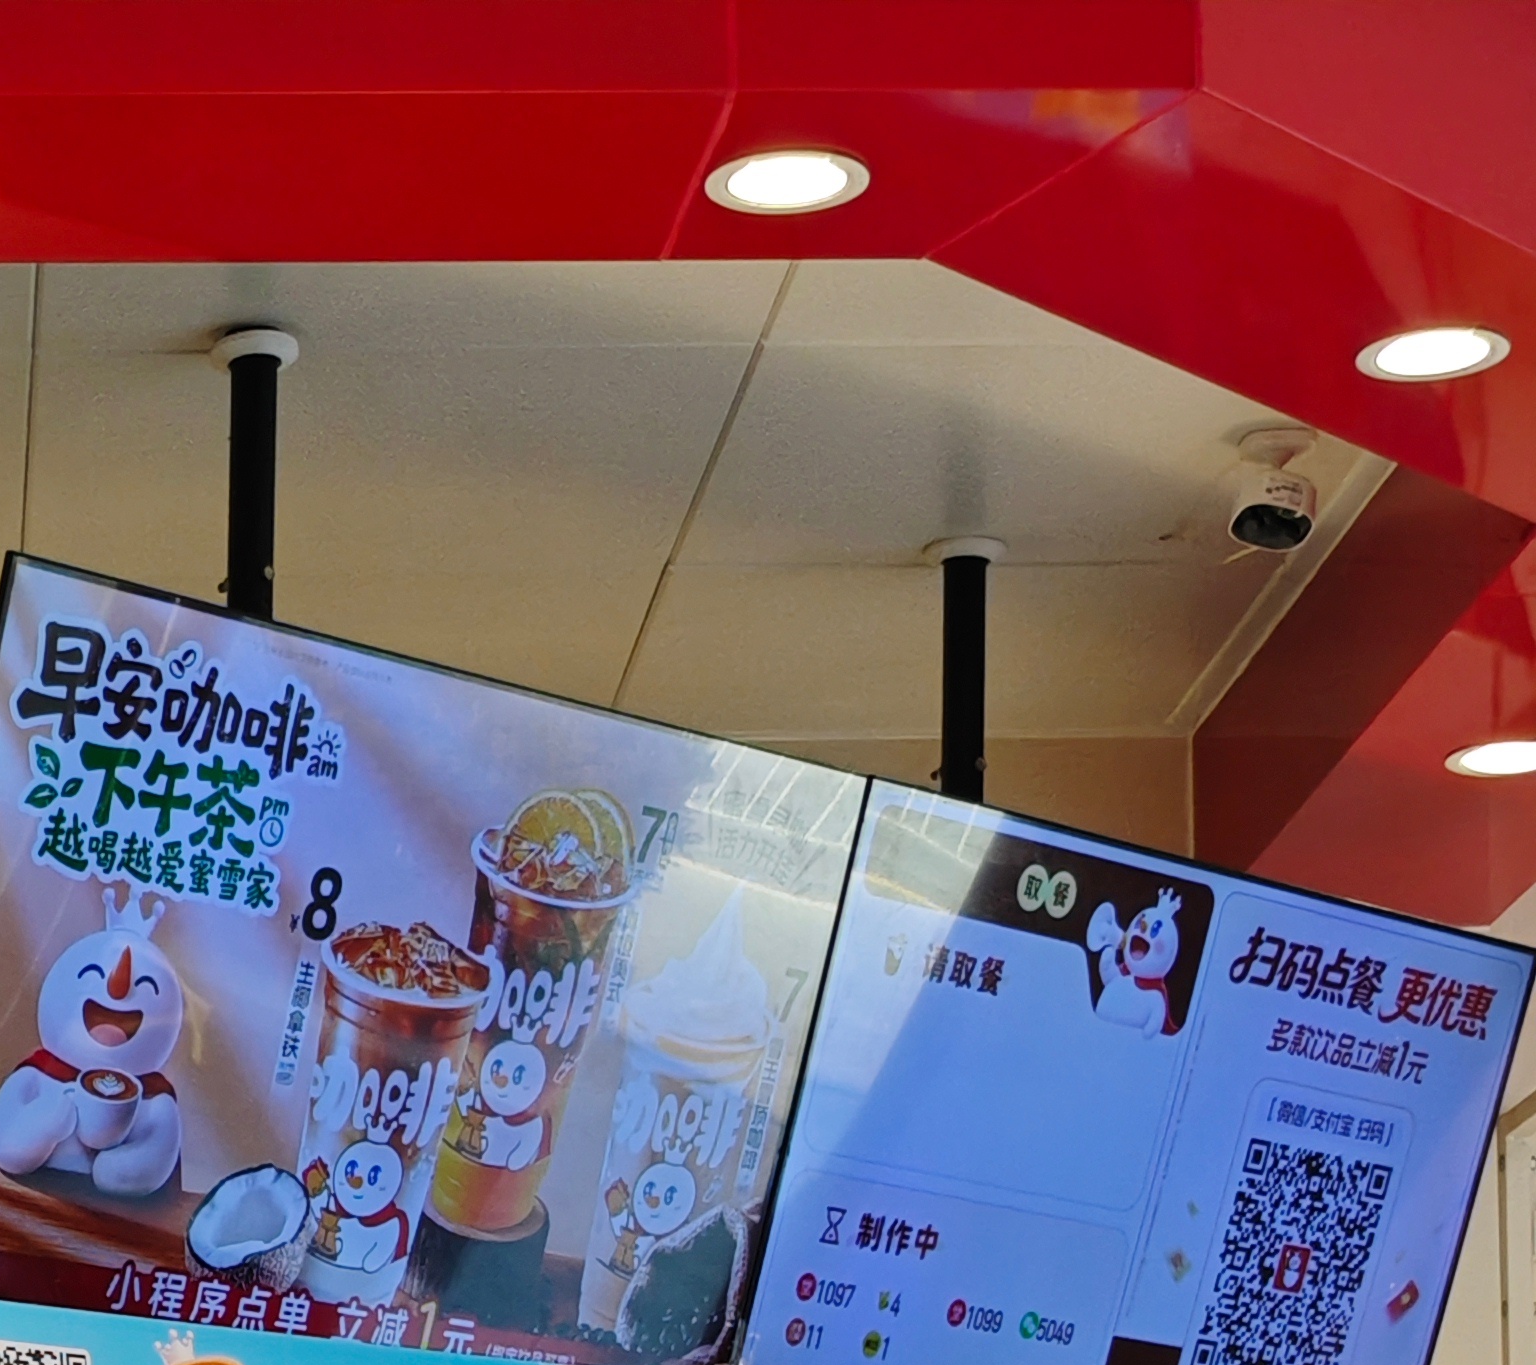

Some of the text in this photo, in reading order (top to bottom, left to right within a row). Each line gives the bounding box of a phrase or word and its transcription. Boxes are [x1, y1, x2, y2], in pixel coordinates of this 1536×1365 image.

[17, 620, 315, 780] 早安咖啡
[307, 753, 338, 780] am
[80, 741, 290, 857] 下午茶 pm
[39, 809, 276, 910] 越喝越爱蜜雪家
[1023, 874, 1071, 909] 取餐
[922, 942, 1006, 997] 请取餐
[1229, 926, 1498, 1041] 扫码点餐 更优惠
[1266, 1017, 1430, 1085] 多款饮品立减1元
[855, 1212, 940, 1261] 制作中
[105, 1264, 475, 1356] 小程序点单 立减1元
[816, 1279, 857, 1309] 1097
[965, 1305, 1004, 1334] 1099
